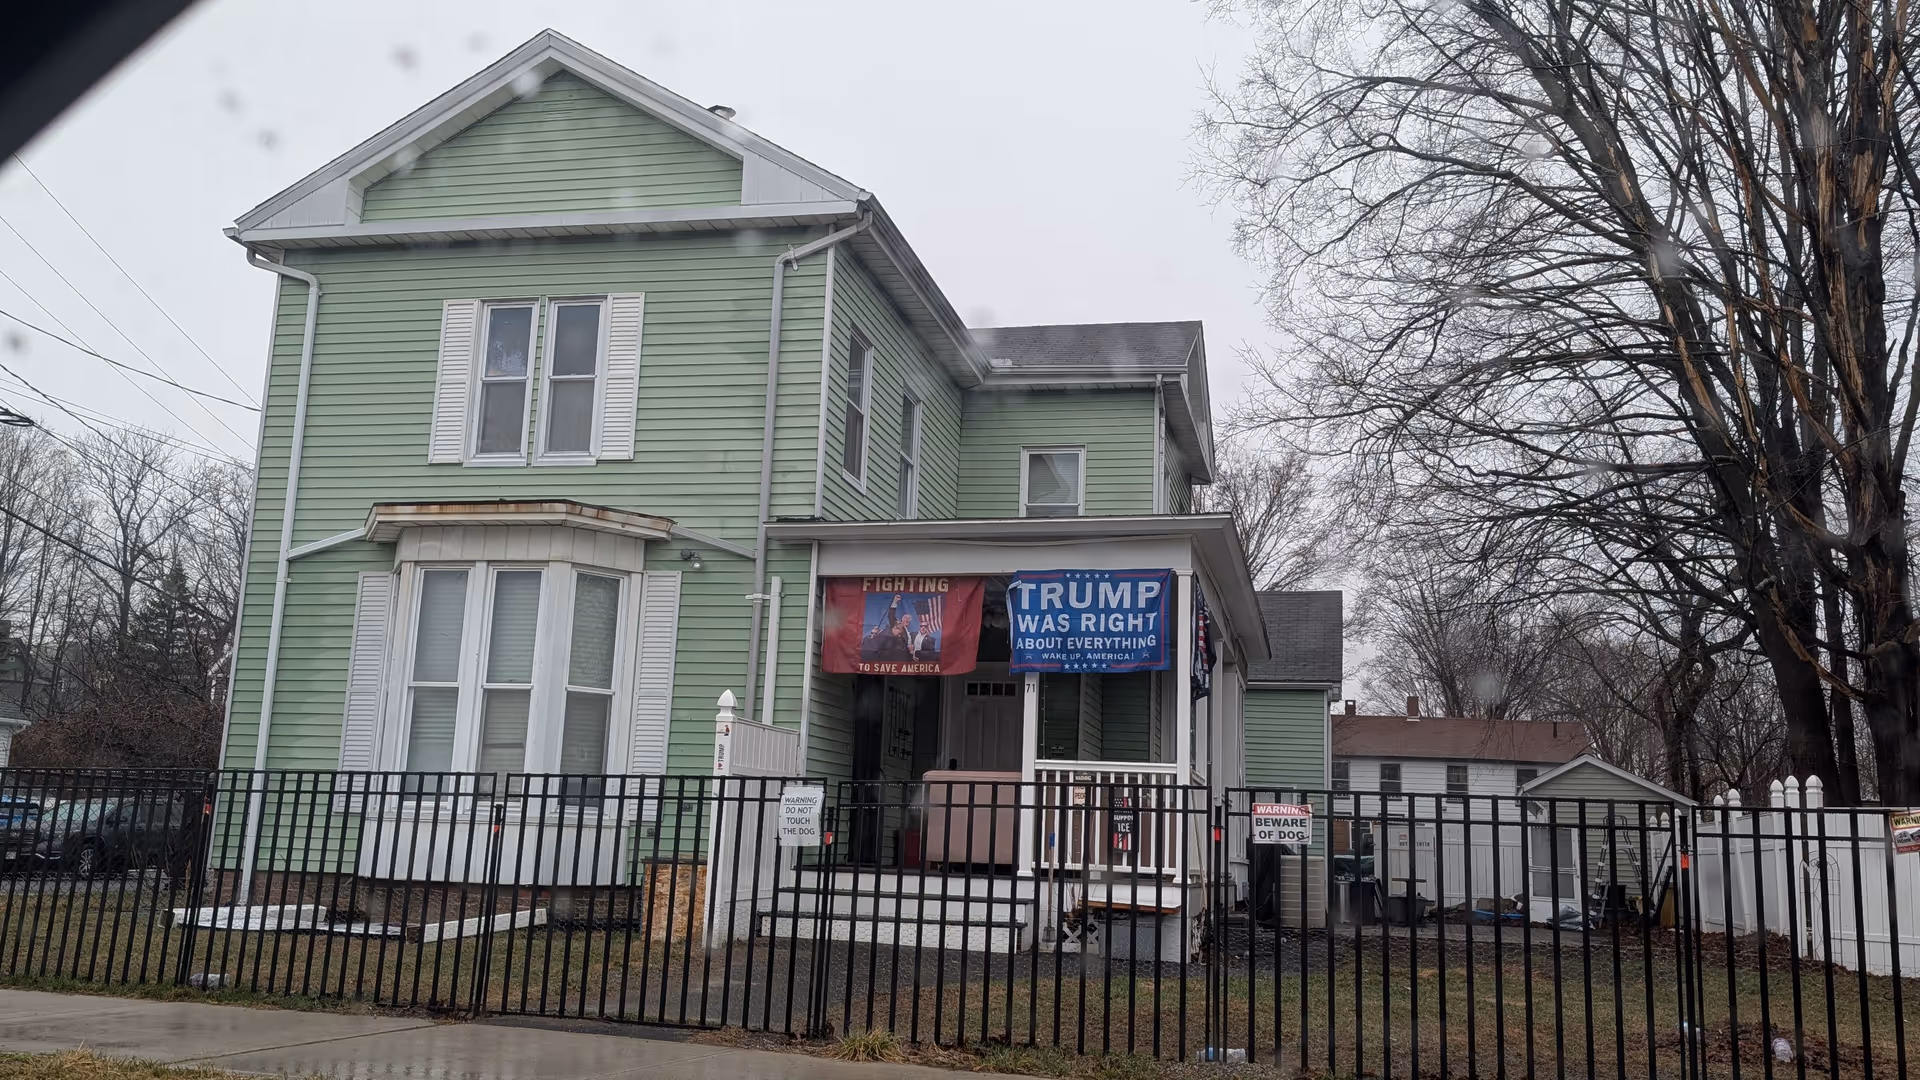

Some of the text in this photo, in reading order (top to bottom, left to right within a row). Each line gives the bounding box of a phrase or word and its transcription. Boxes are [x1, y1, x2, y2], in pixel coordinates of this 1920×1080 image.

[862, 577, 949, 593] FIGHTING
[1017, 581, 1161, 610] TRUMP
[1017, 612, 1157, 633] WAS RIGHT
[1016, 634, 1156, 650] ABOUT EVERYTHING
[1041, 652, 1067, 661] WAKE
[1086, 652, 1134, 661] AMERICA!
[858, 663, 940, 673] TO SAVE AMERICA
[1026, 683, 1035, 693] 71
[717, 743, 725, 762] TRUMP
[1256, 805, 1306, 815] WARNING
[786, 817, 810, 825] TOUCH
[1255, 818, 1307, 827] BEWARE
[783, 827, 815, 835] THE DOG
[1117, 823, 1130, 832] ICE
[1258, 831, 1305, 840] OF DOG
